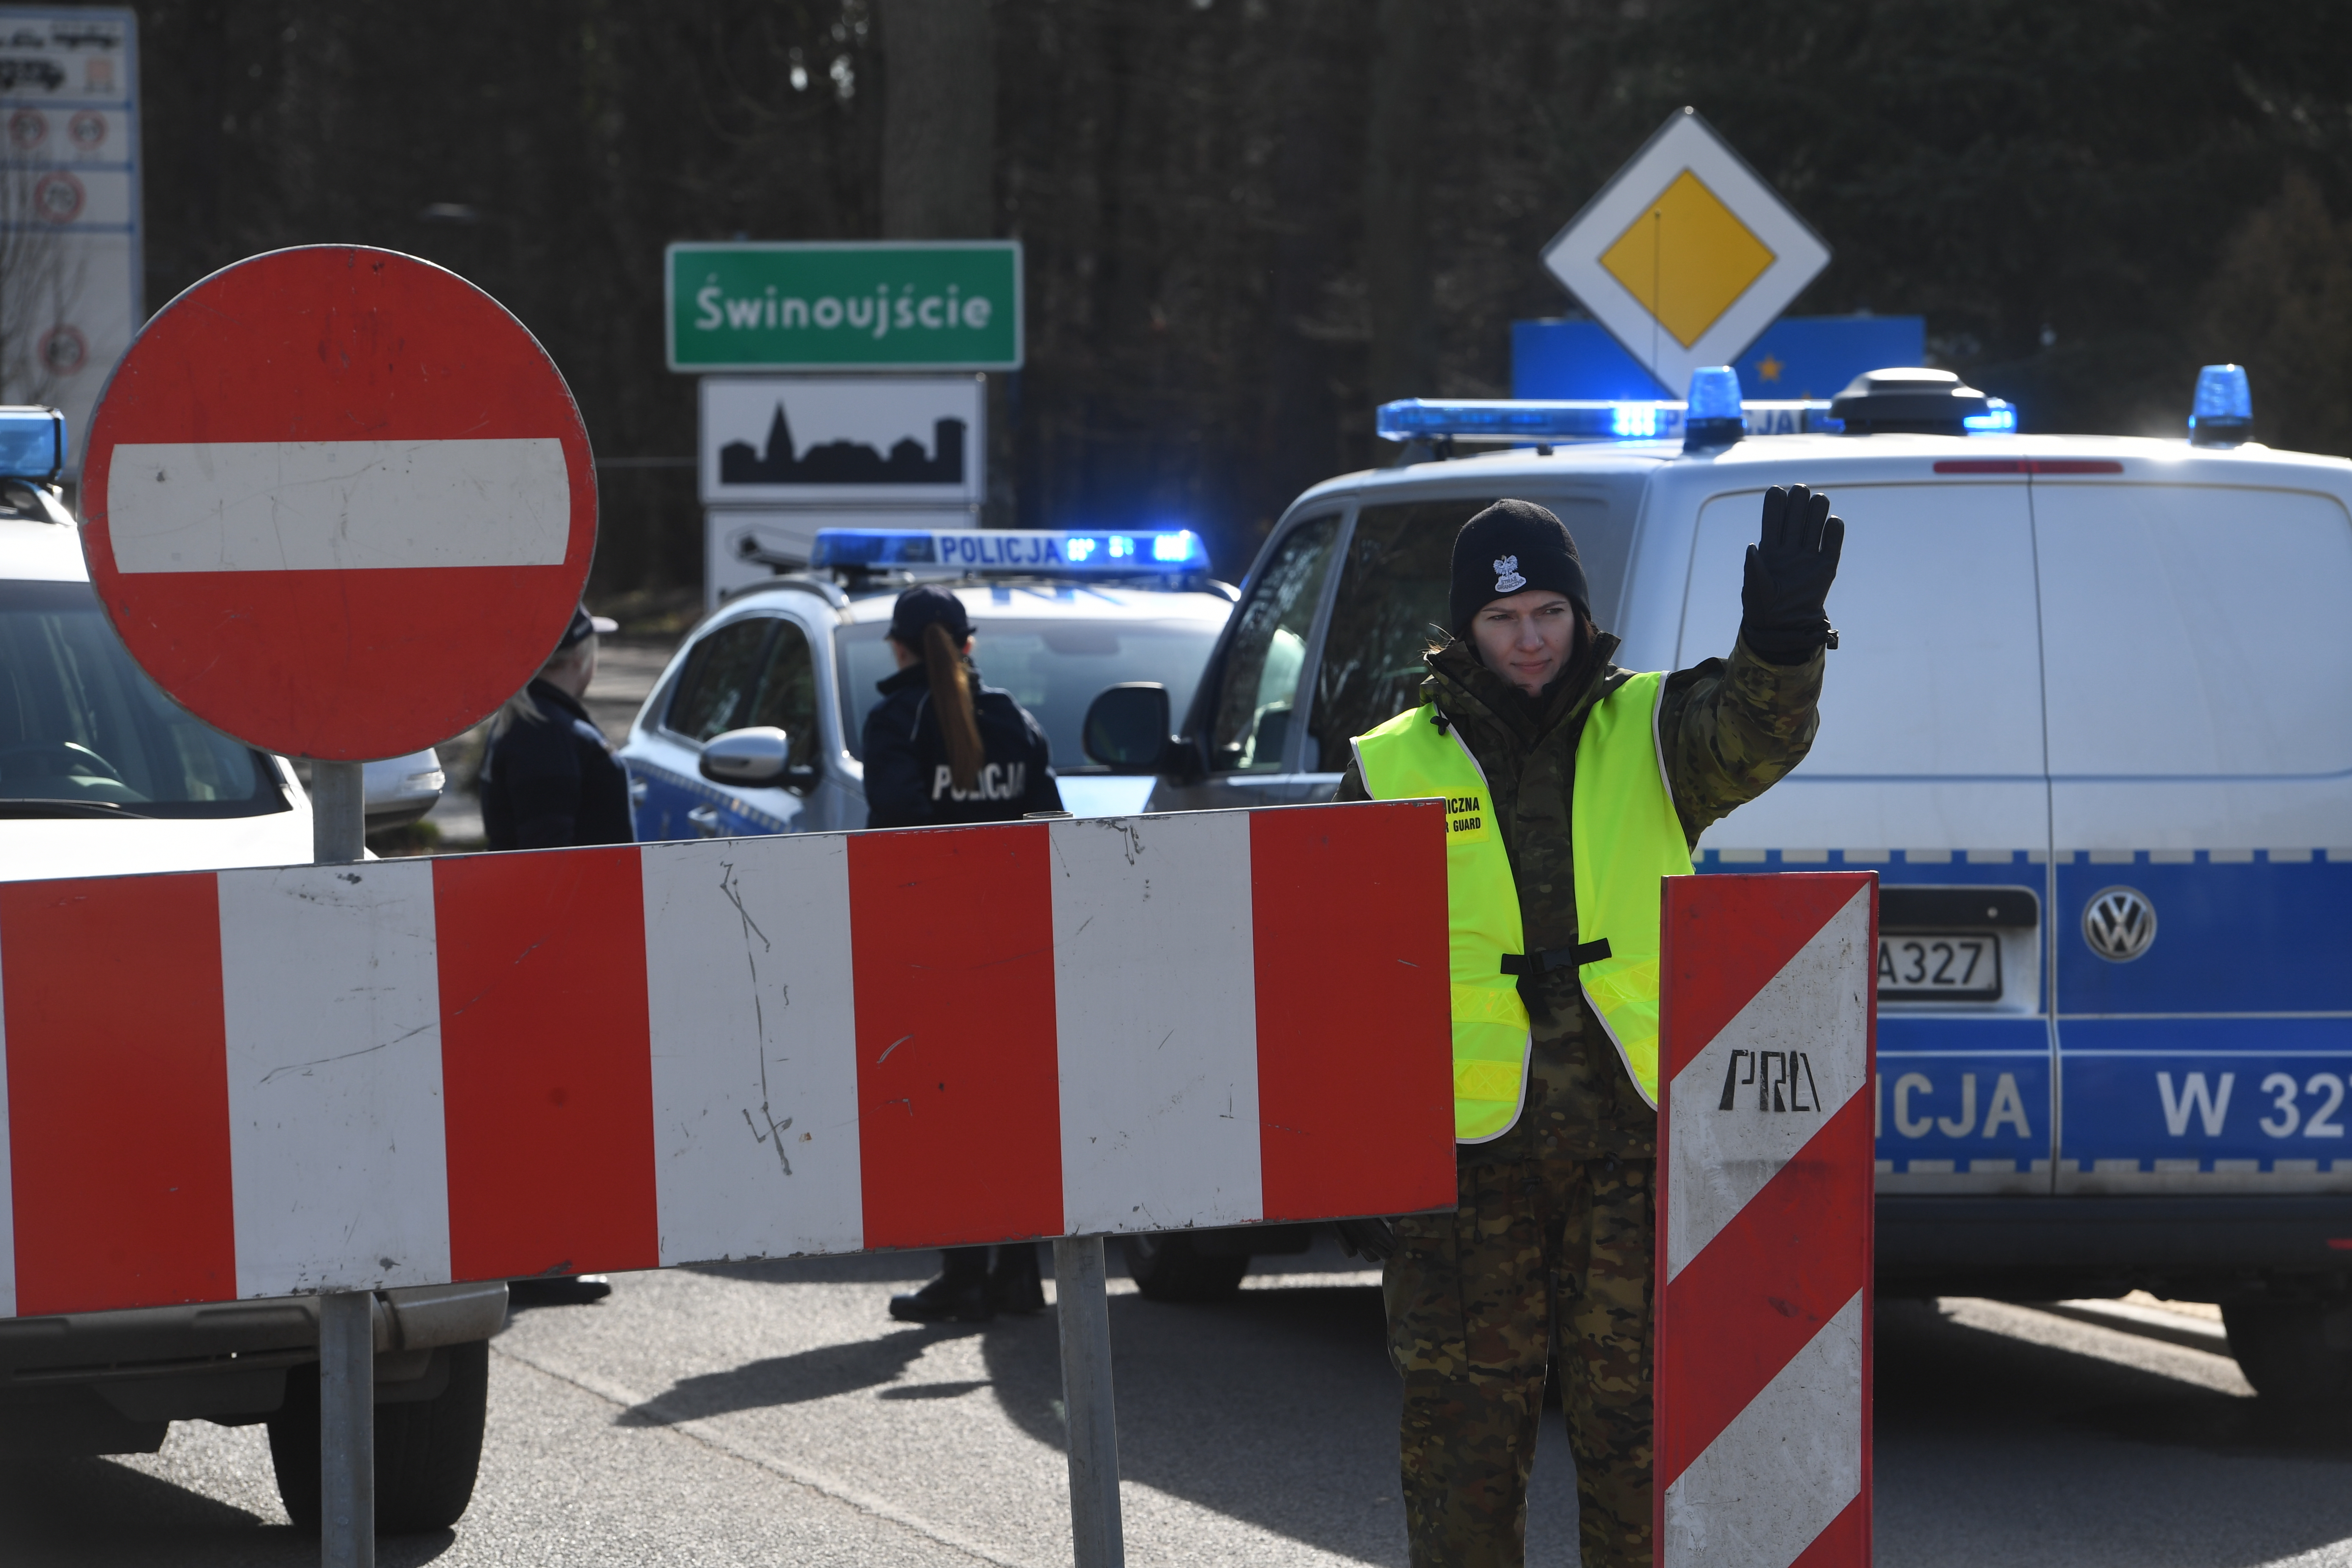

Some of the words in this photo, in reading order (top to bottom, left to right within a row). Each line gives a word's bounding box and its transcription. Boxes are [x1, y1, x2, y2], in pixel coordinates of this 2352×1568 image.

[694, 272, 992, 338] Świnoujście
[940, 536, 1064, 564] POLICJA
[1497, 578, 1524, 590] GRANICZNA
[1446, 797, 1480, 814] ICZNA
[1453, 817, 1481, 832] GUARD
[1878, 941, 1983, 984] A327
[2156, 1072, 2235, 1137] W
[2259, 1072, 2352, 1138] 32
